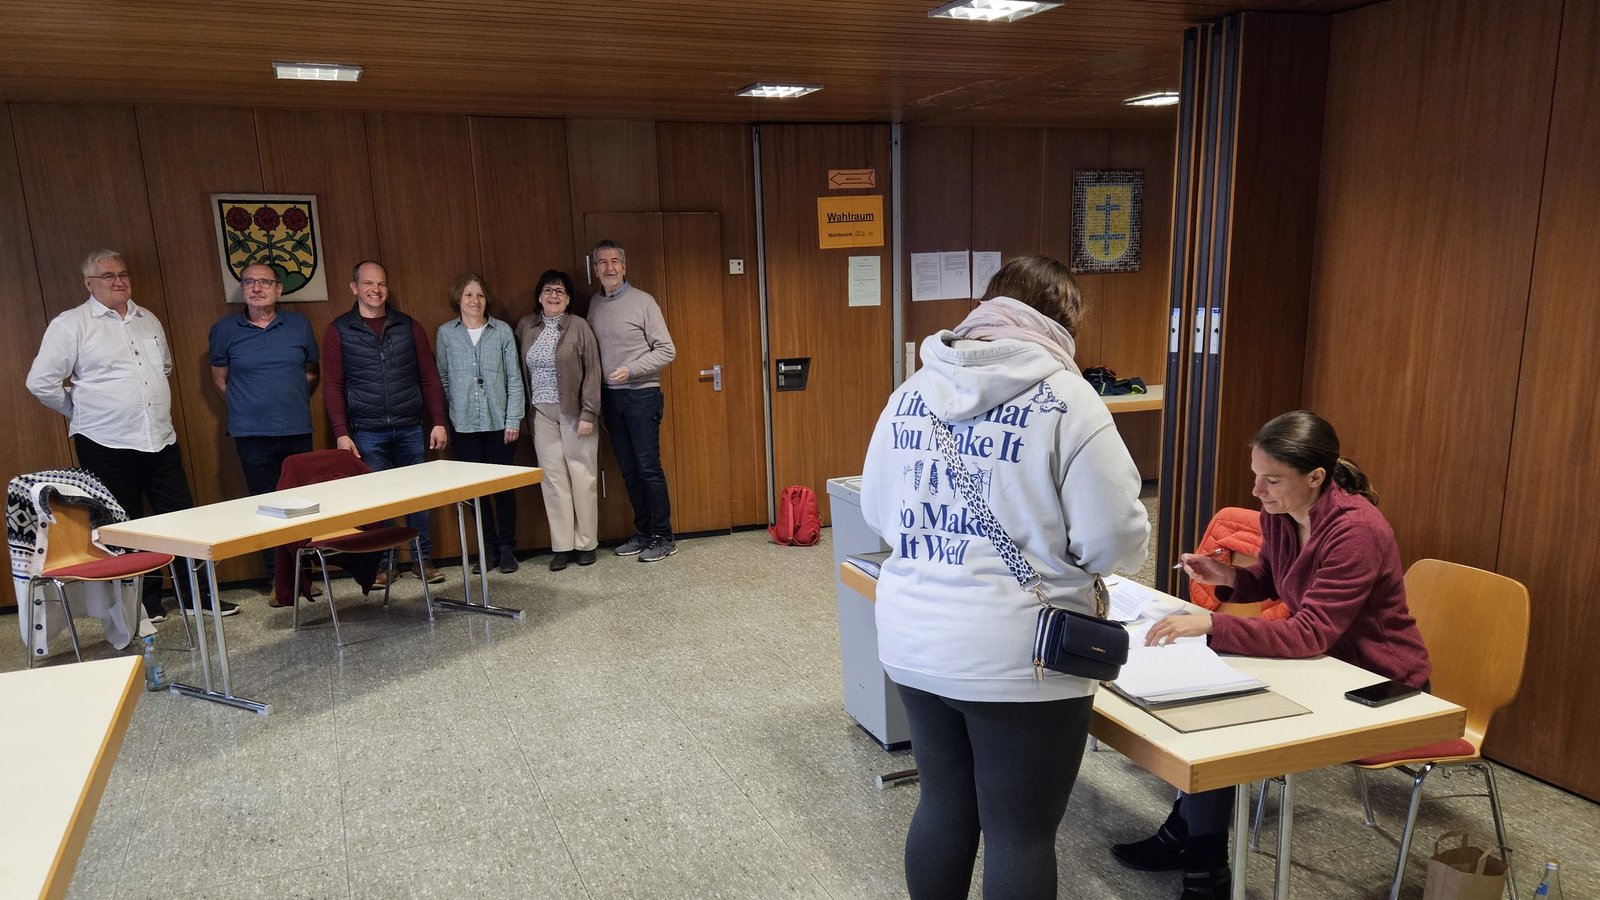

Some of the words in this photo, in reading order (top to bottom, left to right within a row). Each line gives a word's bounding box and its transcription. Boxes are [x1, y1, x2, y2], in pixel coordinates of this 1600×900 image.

[827, 212, 874, 222] Wahlraum
[973, 403, 1034, 428] hat
[892, 422, 922, 450] You
[996, 430, 1025, 463] It
[920, 502, 987, 538] Make
[899, 532, 920, 559] It
[923, 535, 971, 565] Well
